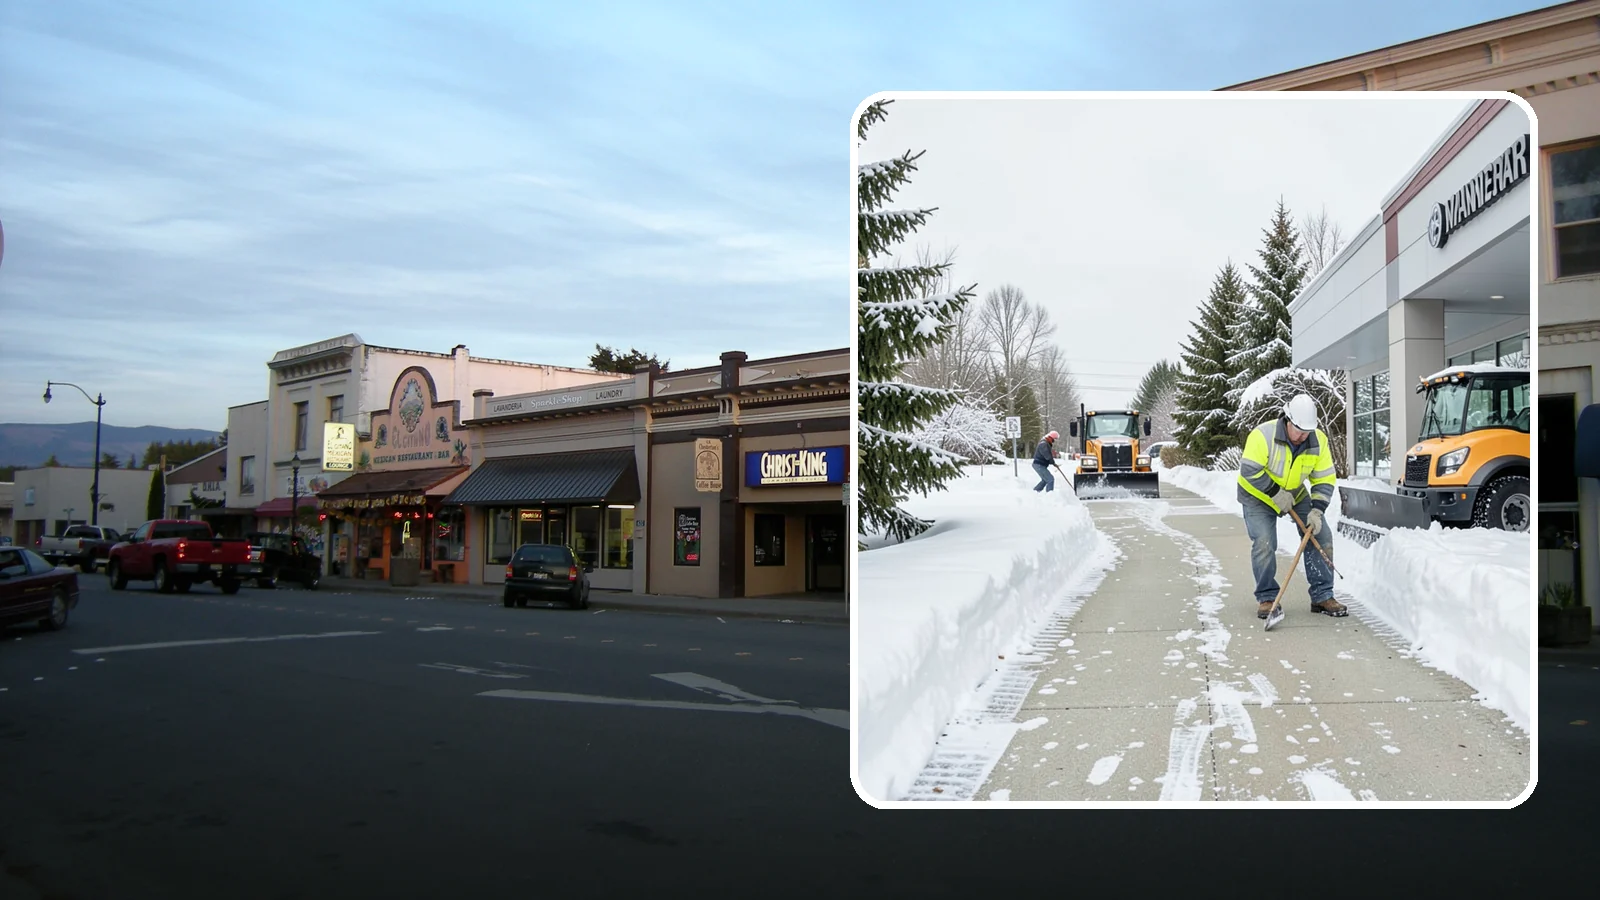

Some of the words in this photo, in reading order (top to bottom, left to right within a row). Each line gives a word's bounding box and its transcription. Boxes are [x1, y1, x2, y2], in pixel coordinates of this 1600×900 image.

[595, 389, 624, 400] LAUNDRY
[493, 402, 523, 413] LAVANDERIA
[530, 396, 561, 410] Sparkle
[561, 394, 583, 405] Shop
[373, 455, 396, 464] MEXICAN
[397, 451, 434, 463] RESTAURANT
[438, 450, 450, 459] BAR
[761, 452, 797, 478] CHRIST
[799, 450, 828, 476] KING
